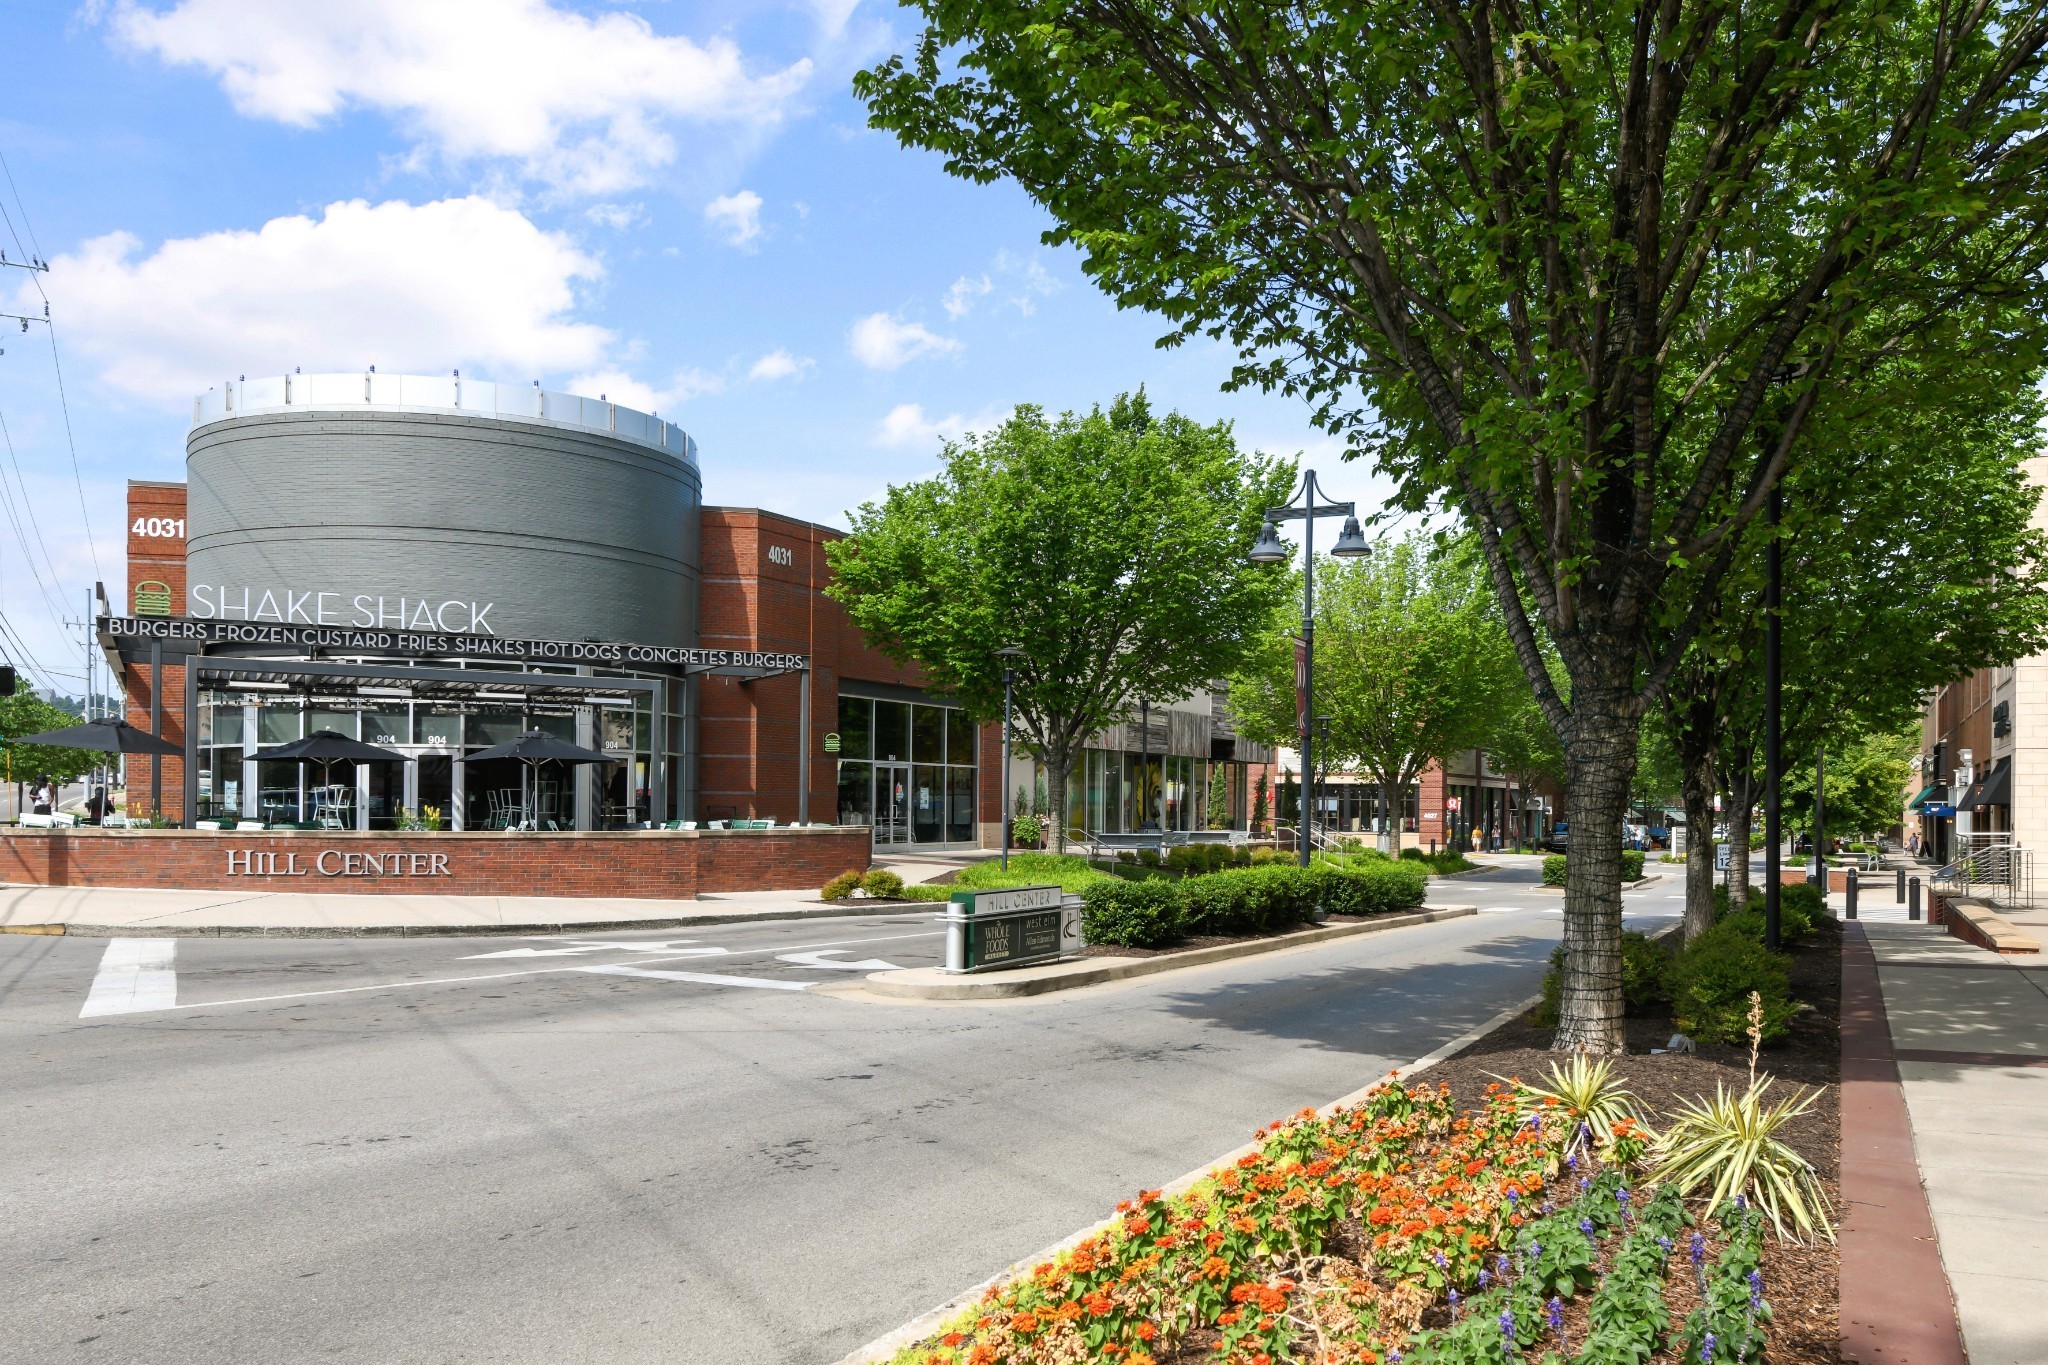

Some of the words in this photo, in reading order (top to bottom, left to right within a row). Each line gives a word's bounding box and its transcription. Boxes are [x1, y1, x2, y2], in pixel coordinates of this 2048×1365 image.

[132, 518, 185, 539] 4031
[768, 545, 792, 566] 4031
[191, 584, 340, 626] SHAKE
[352, 595, 494, 635] SHACK
[109, 619, 207, 640] BURGERS
[215, 624, 297, 644] FROZEN
[301, 630, 391, 649] CUSTARD
[398, 634, 447, 651] FRIES
[455, 637, 525, 656] SHAKES
[531, 642, 571, 657] HOT
[572, 644, 622, 660] DOGS
[628, 647, 728, 665] CONCRETES
[733, 652, 803, 669] BURGERS
[376, 734, 396, 744] 904
[427, 735, 447, 744] 904
[605, 740, 619, 750] 904
[226, 849, 307, 876] HILL
[316, 849, 452, 877] CENTER
[987, 894, 1009, 911] HILL
[1013, 890, 1050, 909] CENTER
[1026, 915, 1042, 929] west
[1043, 914, 1056, 927] elm
[984, 924, 1011, 940] WHOLE
[985, 937, 1010, 954] FOODS
